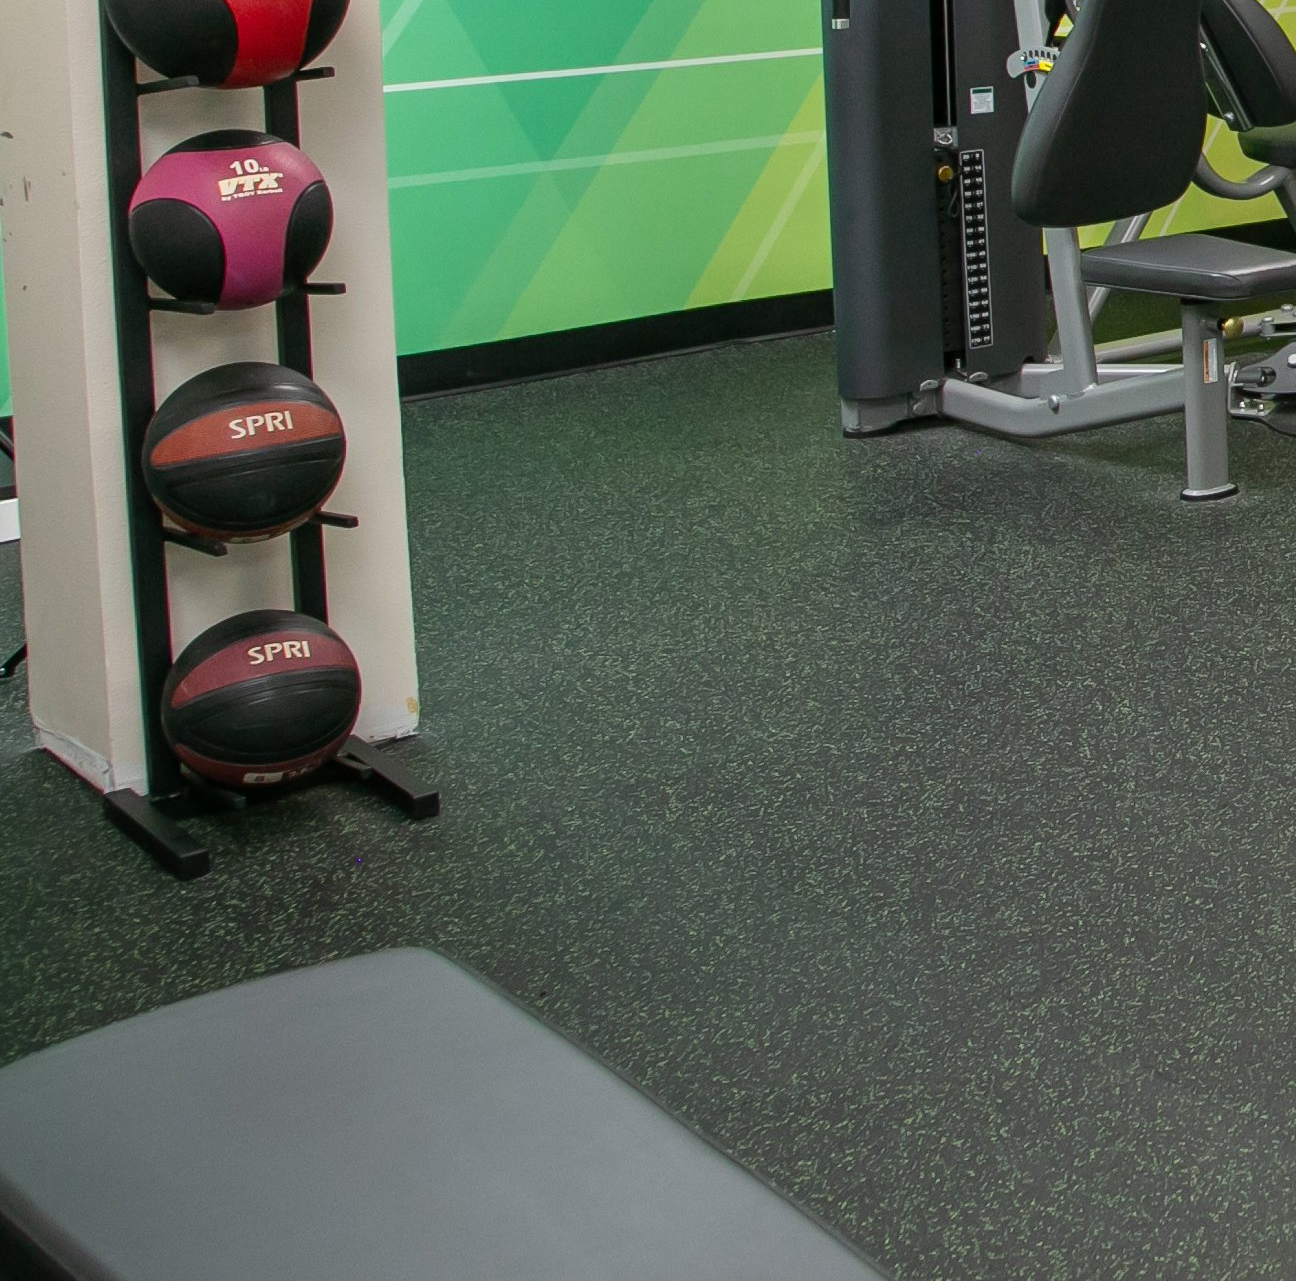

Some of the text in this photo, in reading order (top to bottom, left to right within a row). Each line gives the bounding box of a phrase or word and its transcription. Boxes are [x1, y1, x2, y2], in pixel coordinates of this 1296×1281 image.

[229, 158, 259, 175] 10
[218, 172, 279, 196] VTX
[228, 410, 294, 439] SPRI
[247, 640, 312, 665] SPRI
